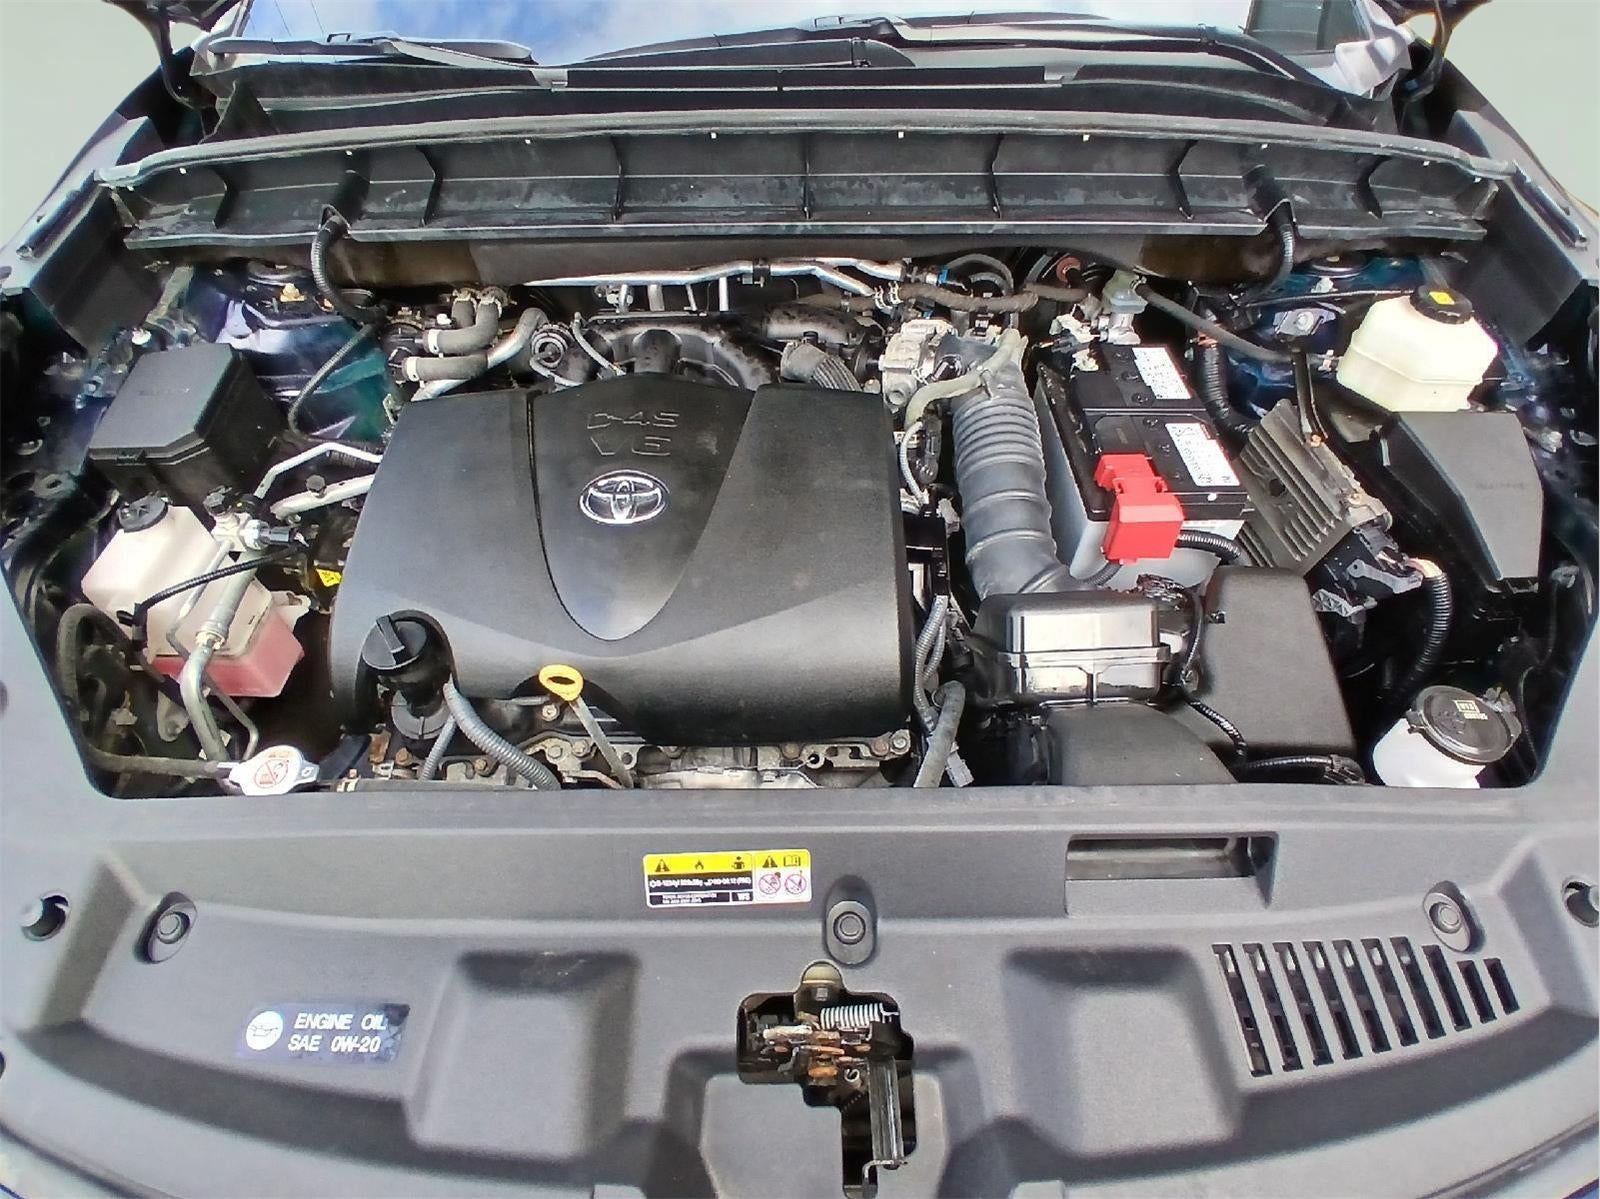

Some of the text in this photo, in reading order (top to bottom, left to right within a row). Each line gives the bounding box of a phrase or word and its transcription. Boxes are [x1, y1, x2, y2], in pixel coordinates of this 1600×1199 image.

[588, 435, 671, 456] V6
[294, 1013, 387, 1030] ENGINE OIL
[287, 1034, 382, 1053] SAE 0W-20
